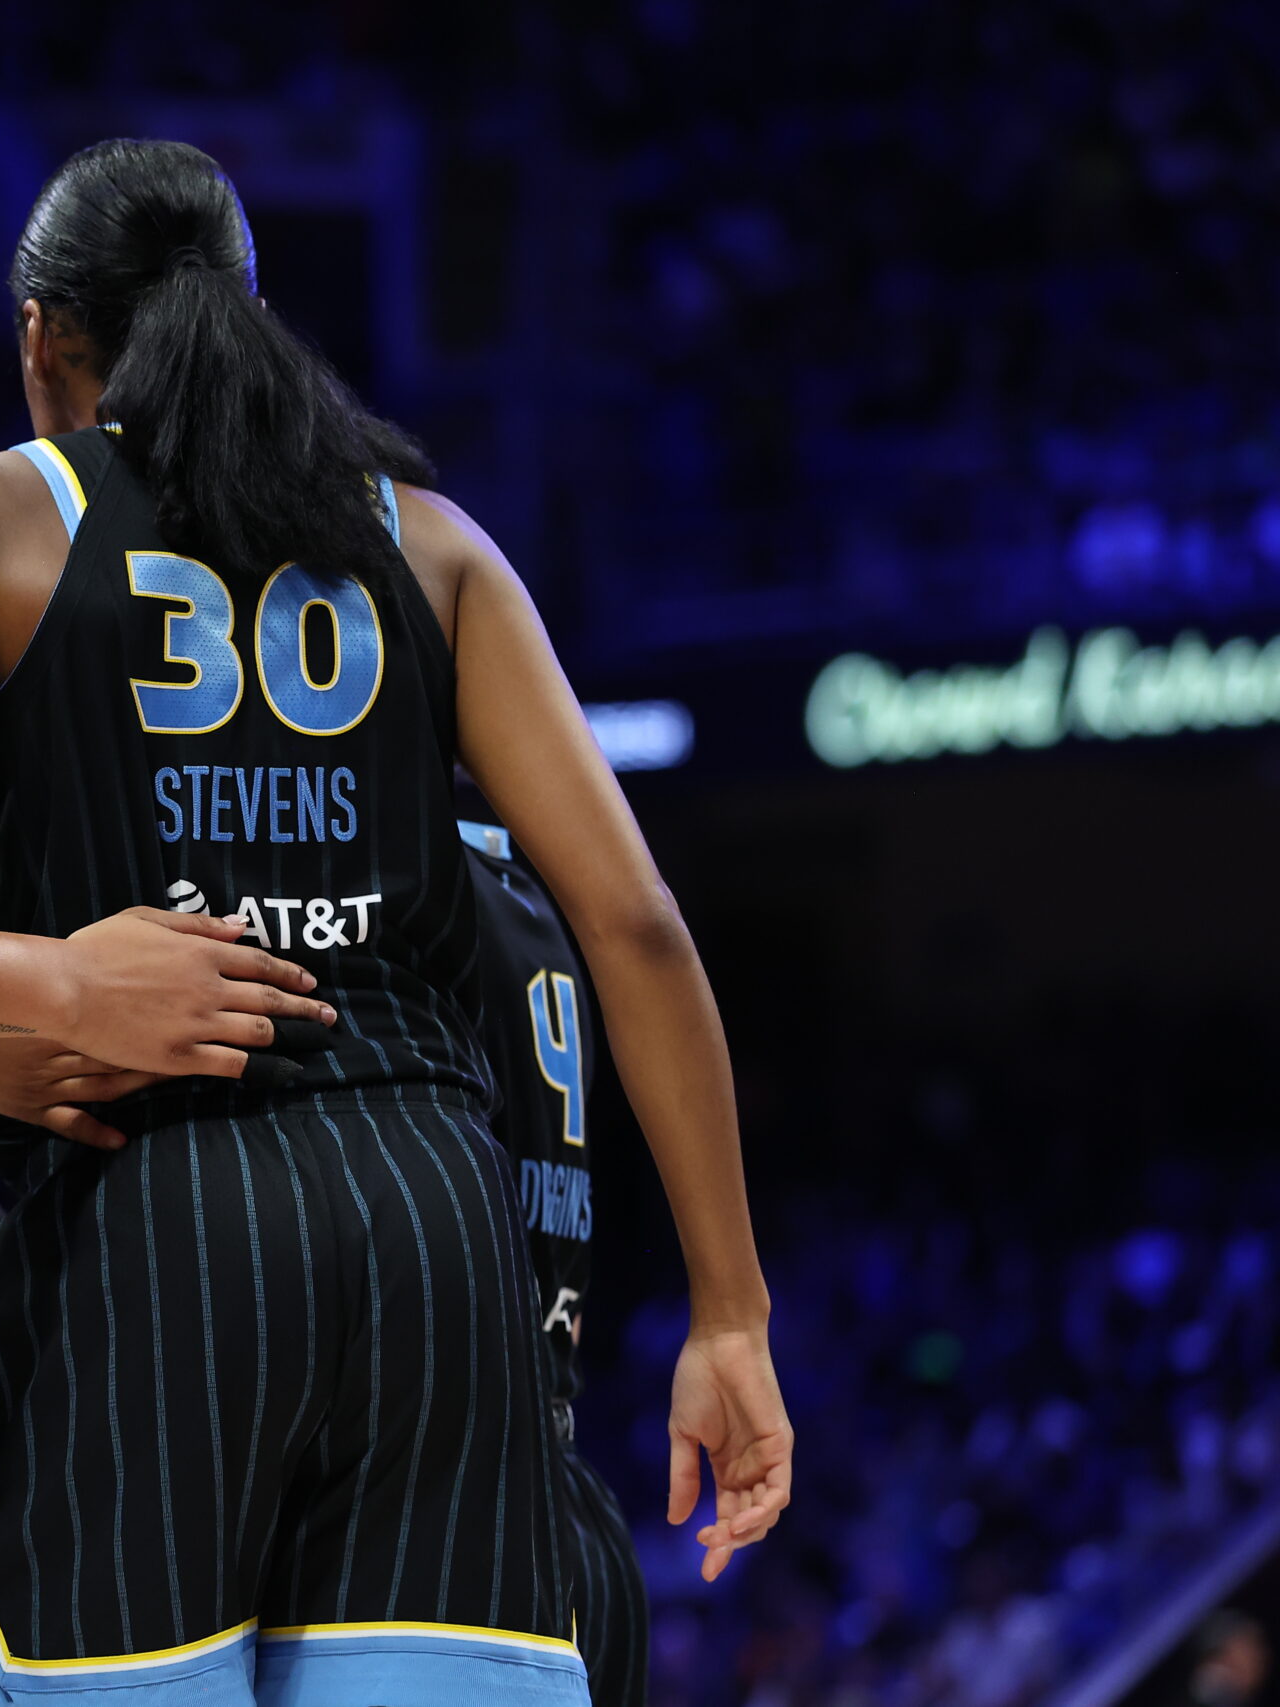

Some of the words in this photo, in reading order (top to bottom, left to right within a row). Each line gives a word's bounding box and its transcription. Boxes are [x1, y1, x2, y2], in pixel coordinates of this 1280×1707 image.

[125, 550, 384, 736] 30
[155, 765, 357, 843] STEVENS
[236, 893, 382, 950] AT&T
[526, 968, 585, 1148] 4
